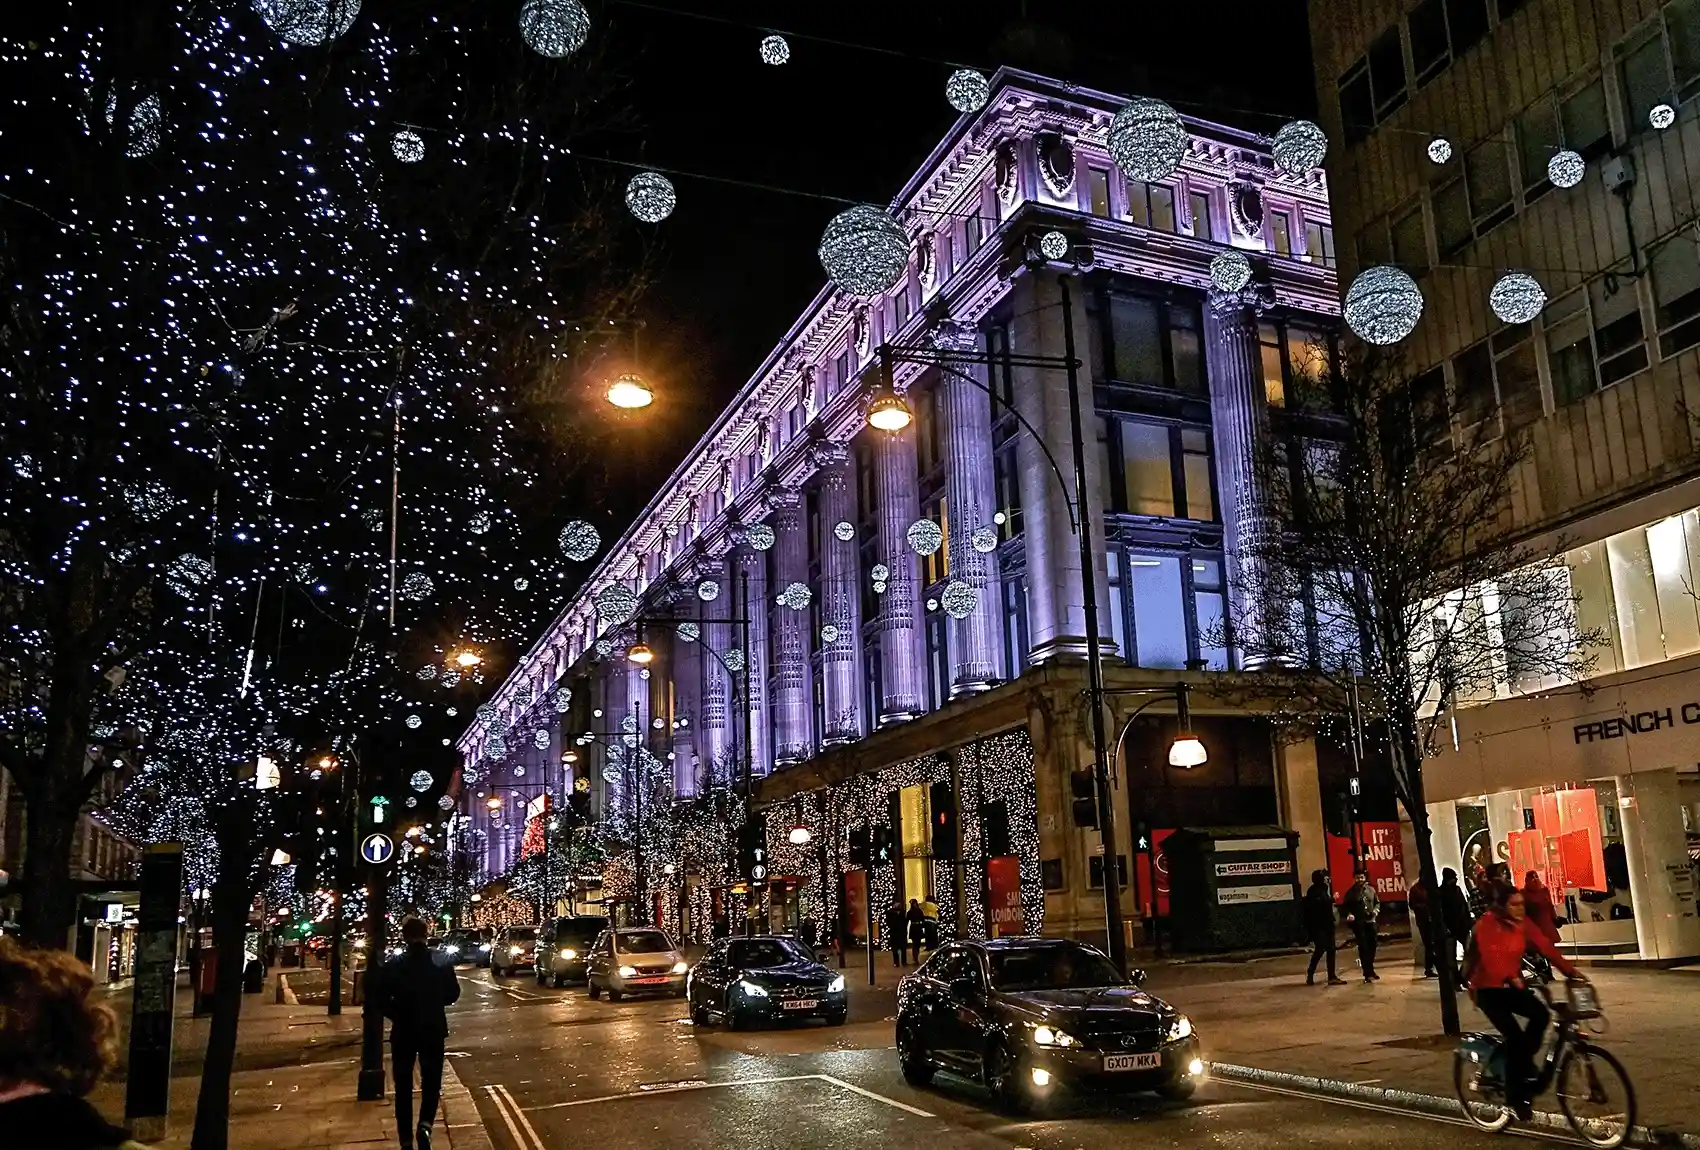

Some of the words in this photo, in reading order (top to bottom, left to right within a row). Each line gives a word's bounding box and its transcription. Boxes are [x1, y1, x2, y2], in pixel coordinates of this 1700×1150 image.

[1573, 707, 1674, 744] FRENCH
[1497, 836, 1562, 872] SALE
[1228, 863, 1260, 872] GUITAR
[1261, 862, 1285, 870] SHOP
[1108, 1056, 1134, 1069] GX07
